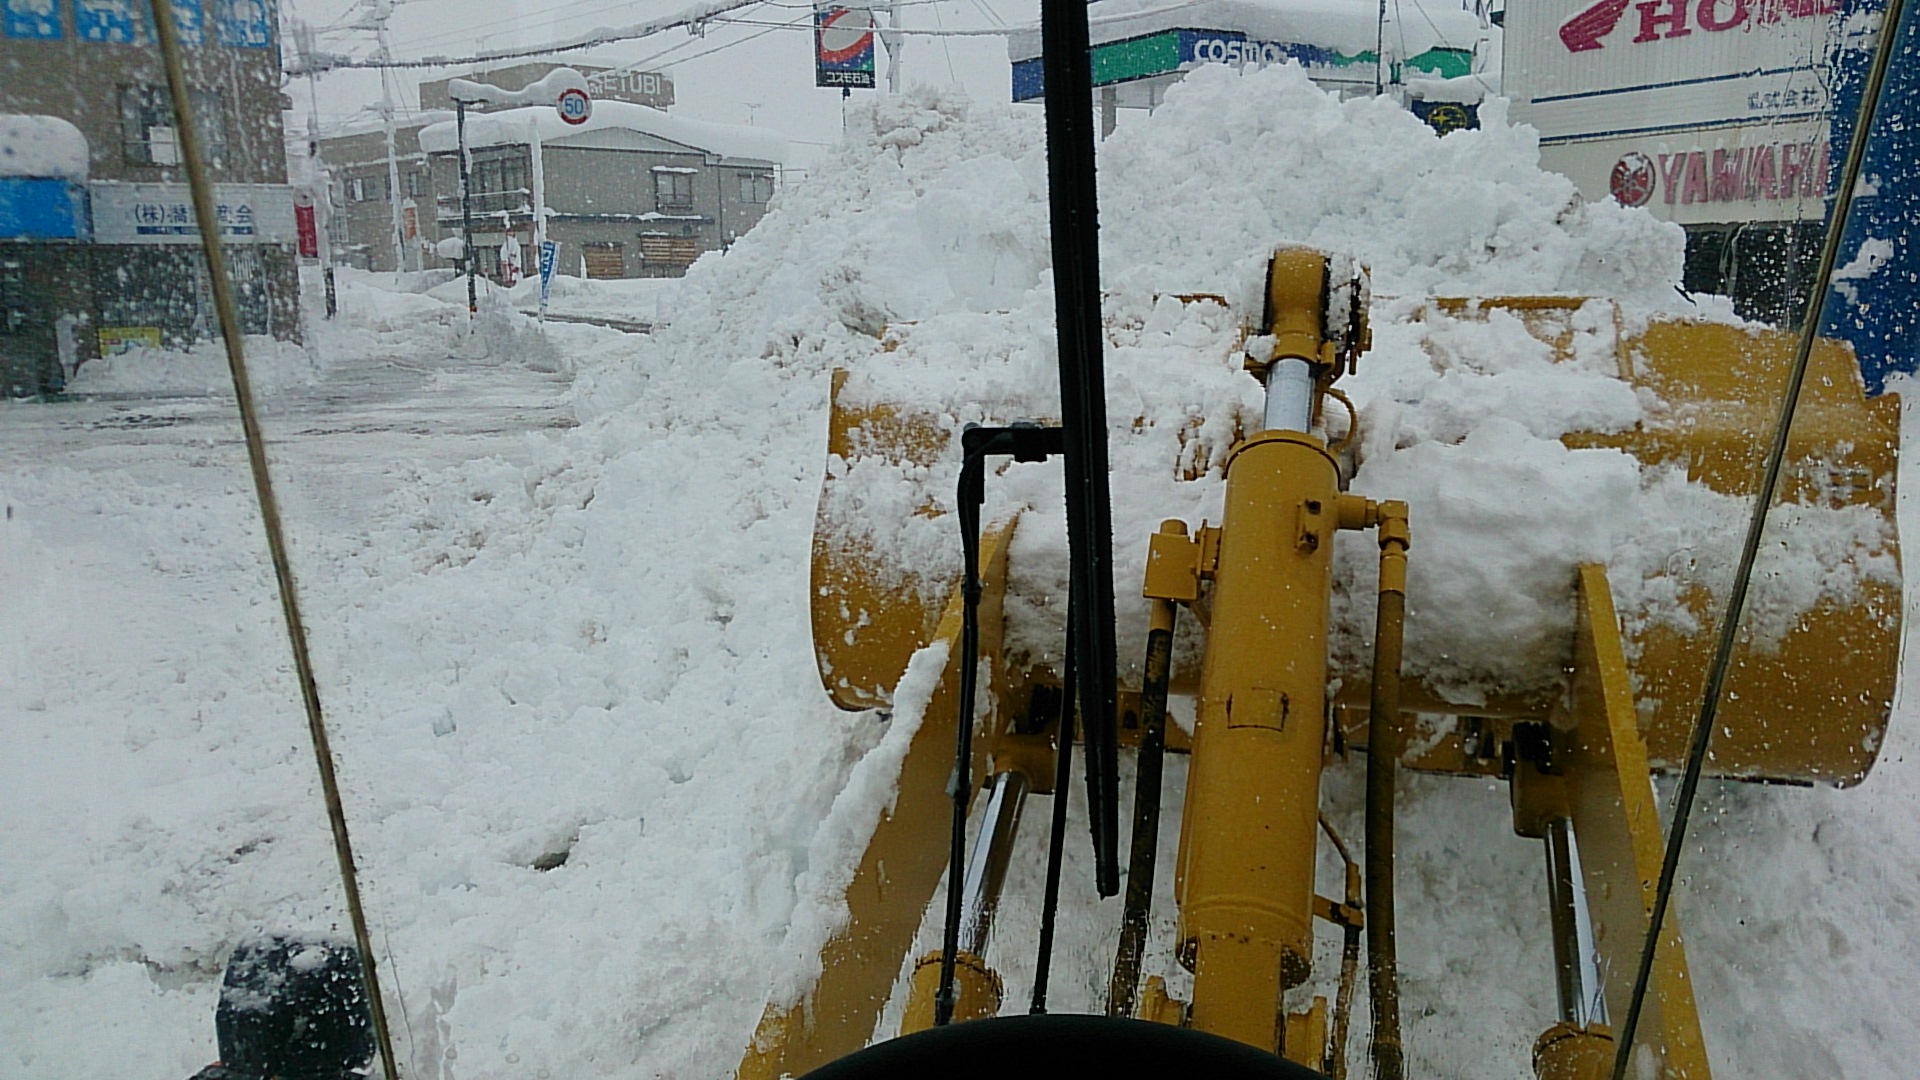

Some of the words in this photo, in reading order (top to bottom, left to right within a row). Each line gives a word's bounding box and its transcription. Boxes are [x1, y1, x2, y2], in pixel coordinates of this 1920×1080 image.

[826, 71, 870, 84] コスモ石油
[565, 97, 584, 114] 50
